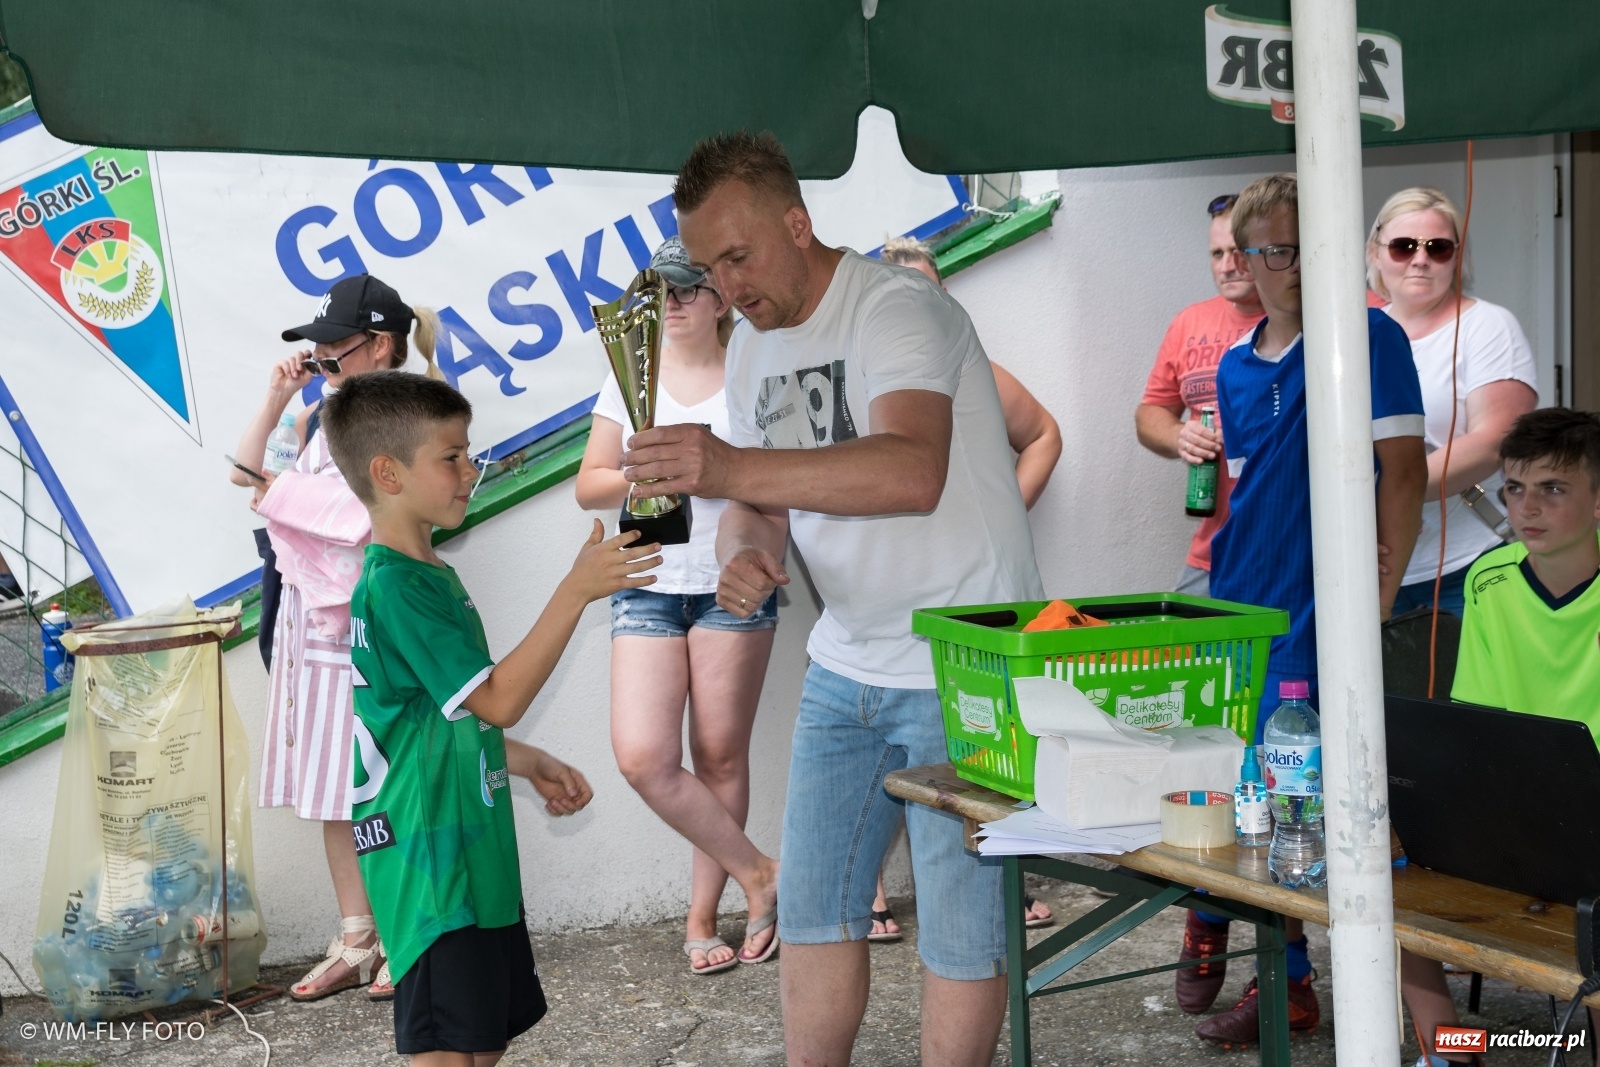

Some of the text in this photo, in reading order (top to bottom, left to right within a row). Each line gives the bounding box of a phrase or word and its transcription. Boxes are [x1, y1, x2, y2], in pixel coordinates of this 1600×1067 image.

[0, 160, 141, 237] GÓRKI ŚL.
[60, 221, 116, 258] LKS
[1272, 383, 1280, 417] KIPSTA
[1120, 699, 1180, 715] Delikatesy
[97, 774, 155, 787] KOMART
